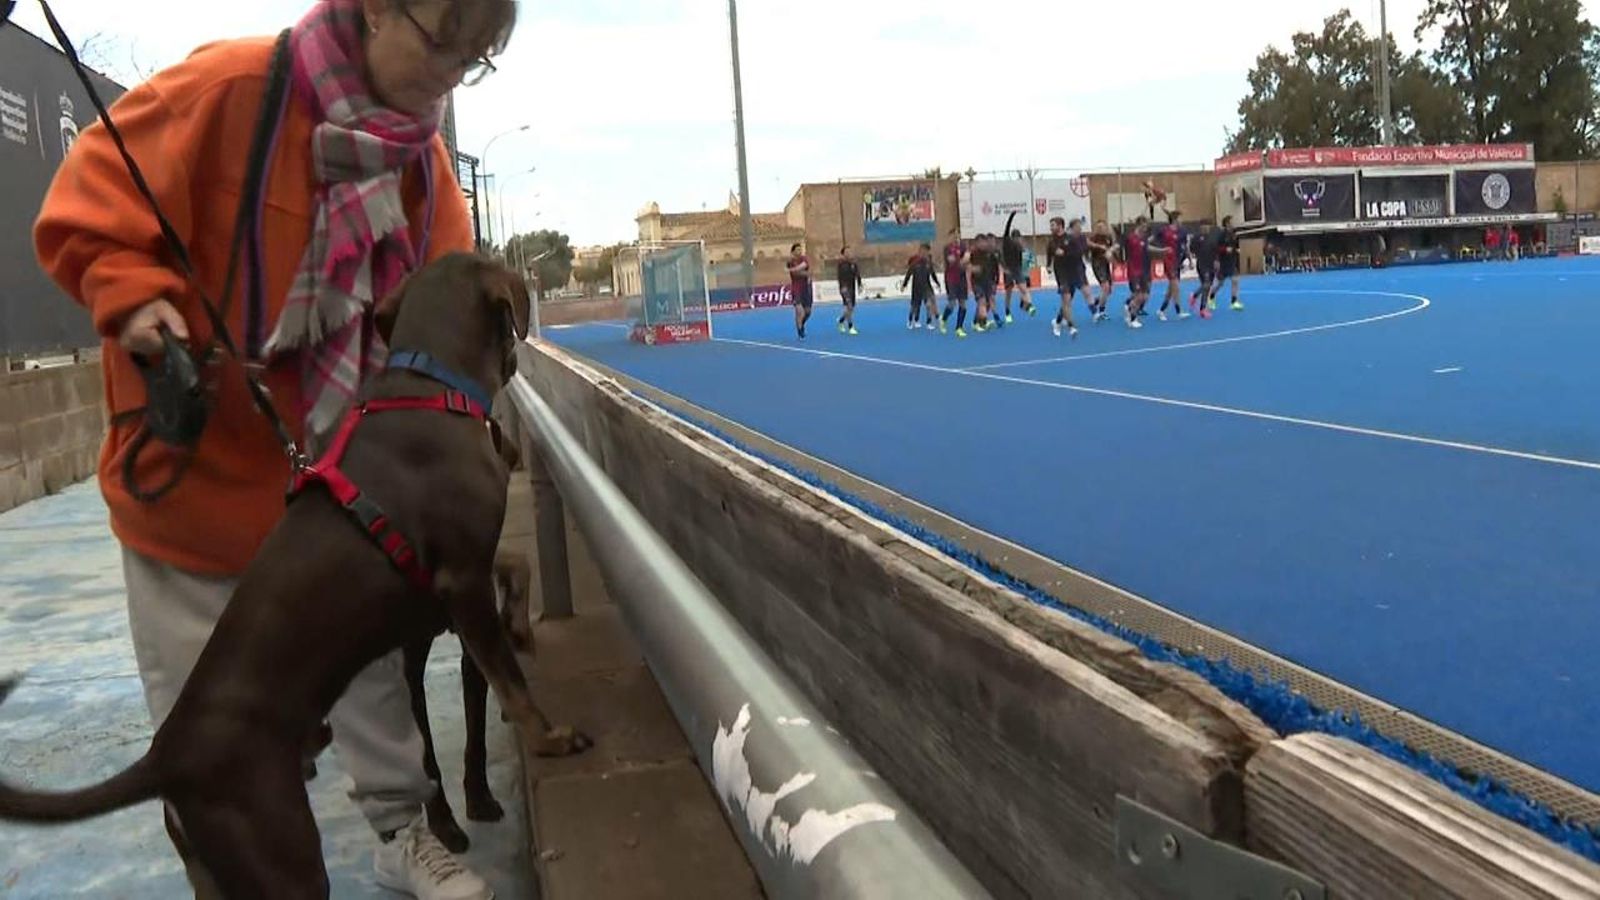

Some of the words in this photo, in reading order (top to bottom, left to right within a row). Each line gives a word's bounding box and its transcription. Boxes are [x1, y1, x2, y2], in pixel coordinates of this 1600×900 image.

[1435, 148, 1476, 161] Municipal
[1477, 149, 1488, 159] de
[1365, 201, 1380, 218] LA
[1381, 200, 1407, 217] COPA
